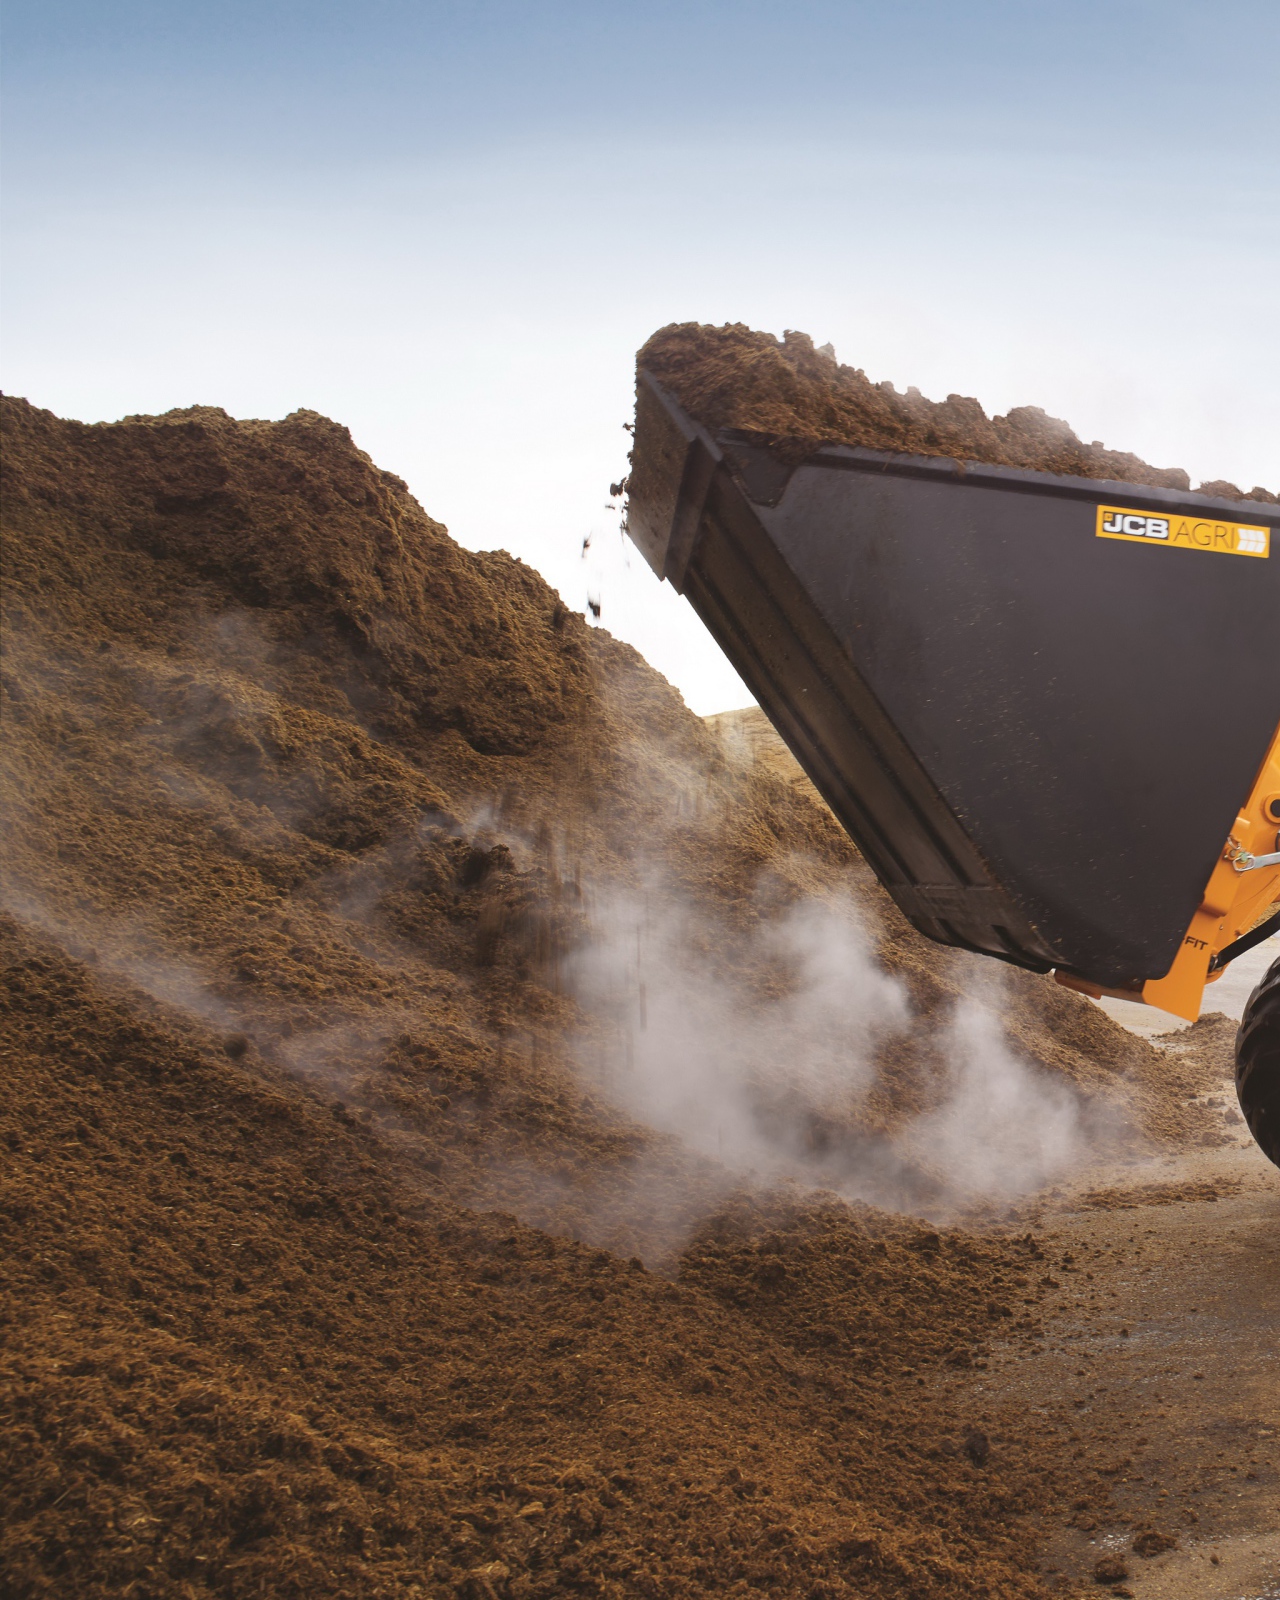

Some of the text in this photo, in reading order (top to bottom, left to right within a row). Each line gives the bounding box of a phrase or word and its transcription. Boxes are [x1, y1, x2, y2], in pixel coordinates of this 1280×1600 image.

[1103, 514, 1235, 549] JCB AGRI
[1182, 935, 1209, 951] FIT
